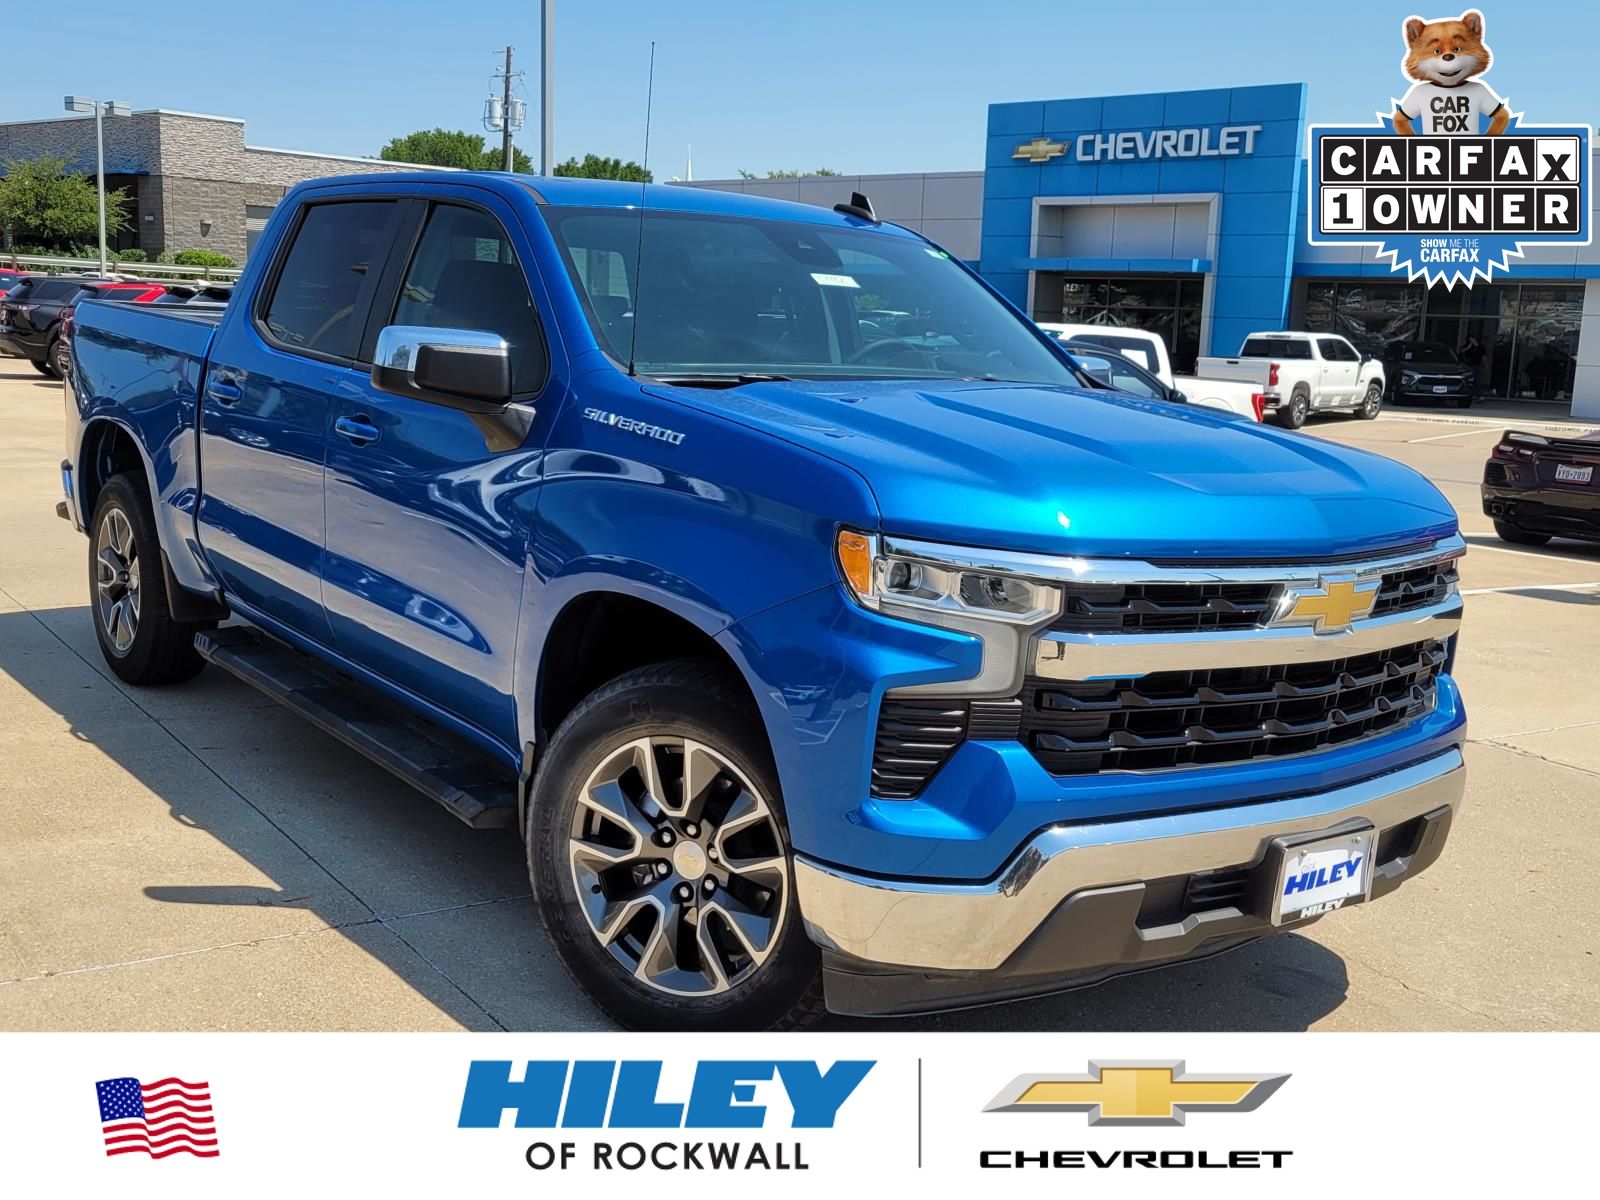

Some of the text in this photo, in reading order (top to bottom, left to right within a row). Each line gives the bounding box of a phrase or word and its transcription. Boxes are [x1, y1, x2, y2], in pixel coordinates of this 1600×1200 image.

[1076, 125, 1263, 162] CHEVROLET
[583, 407, 686, 445] SILVERADO
[1283, 855, 1364, 896] HILEY
[1300, 898, 1346, 919] HILEY
